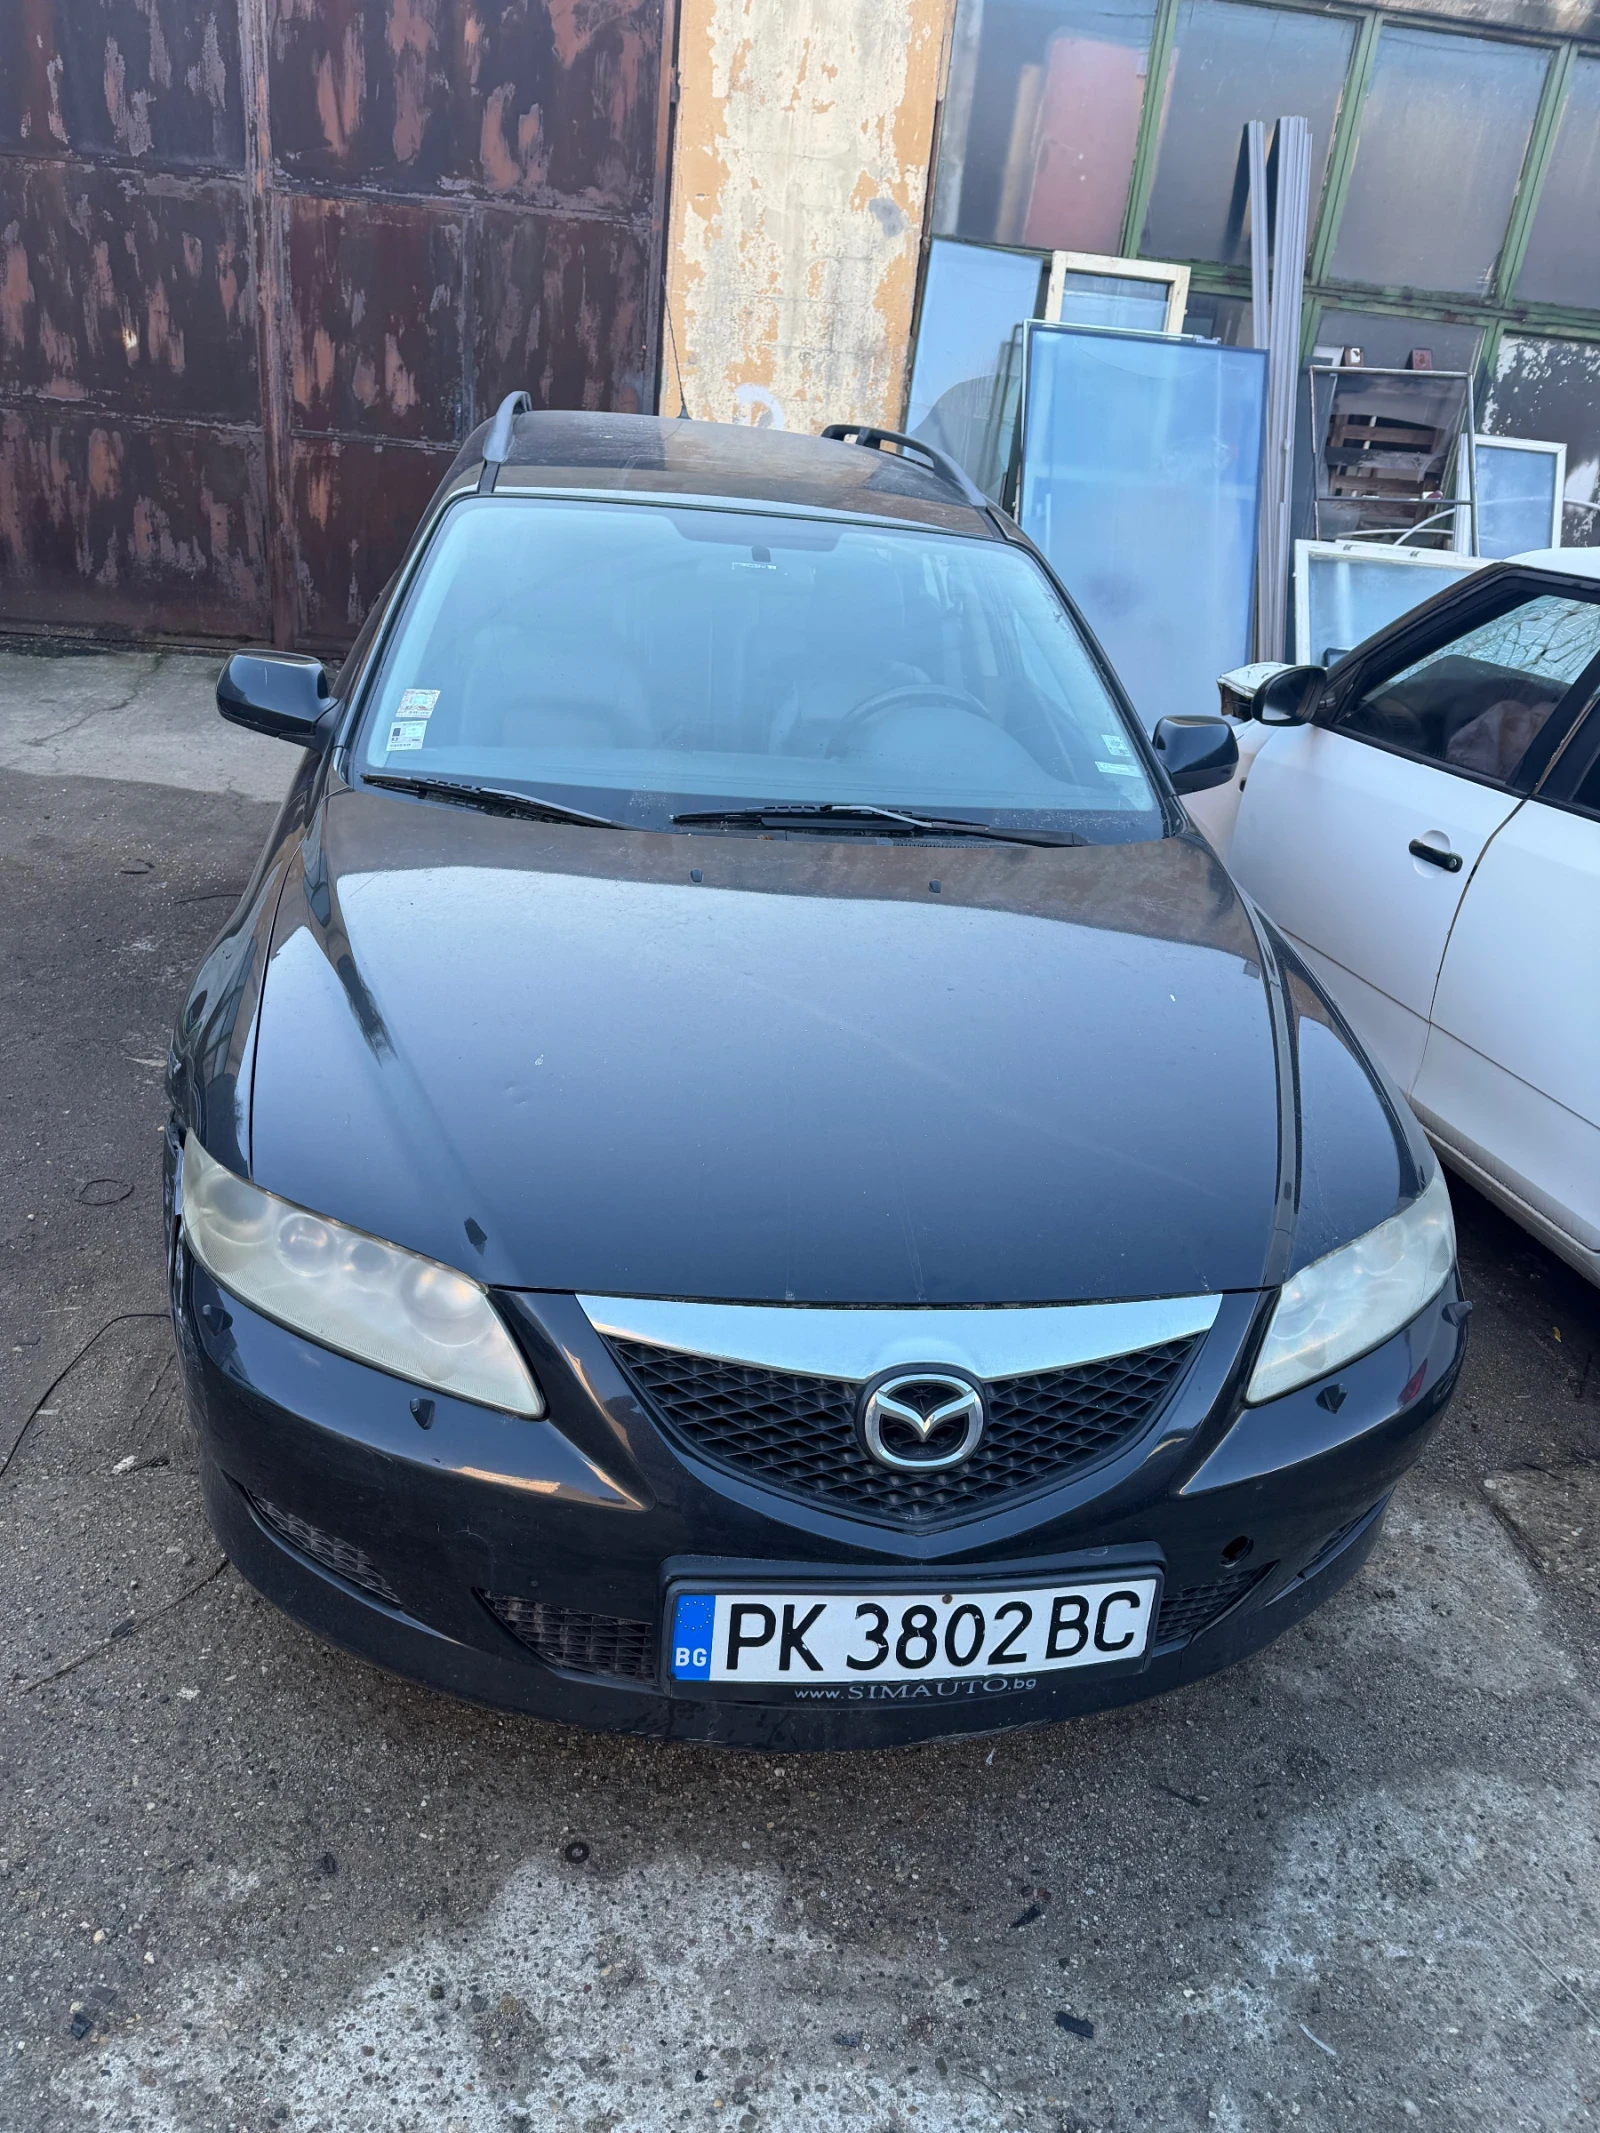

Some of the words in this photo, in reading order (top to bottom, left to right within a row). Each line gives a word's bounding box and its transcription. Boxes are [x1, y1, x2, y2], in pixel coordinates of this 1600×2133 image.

[726, 1603, 828, 1671] PK
[846, 1601, 1033, 1671] 3802
[1045, 1590, 1140, 1659] BC
[675, 1647, 707, 1667] BG
[795, 1677, 1036, 1700] www.SIMAUTO.bg
